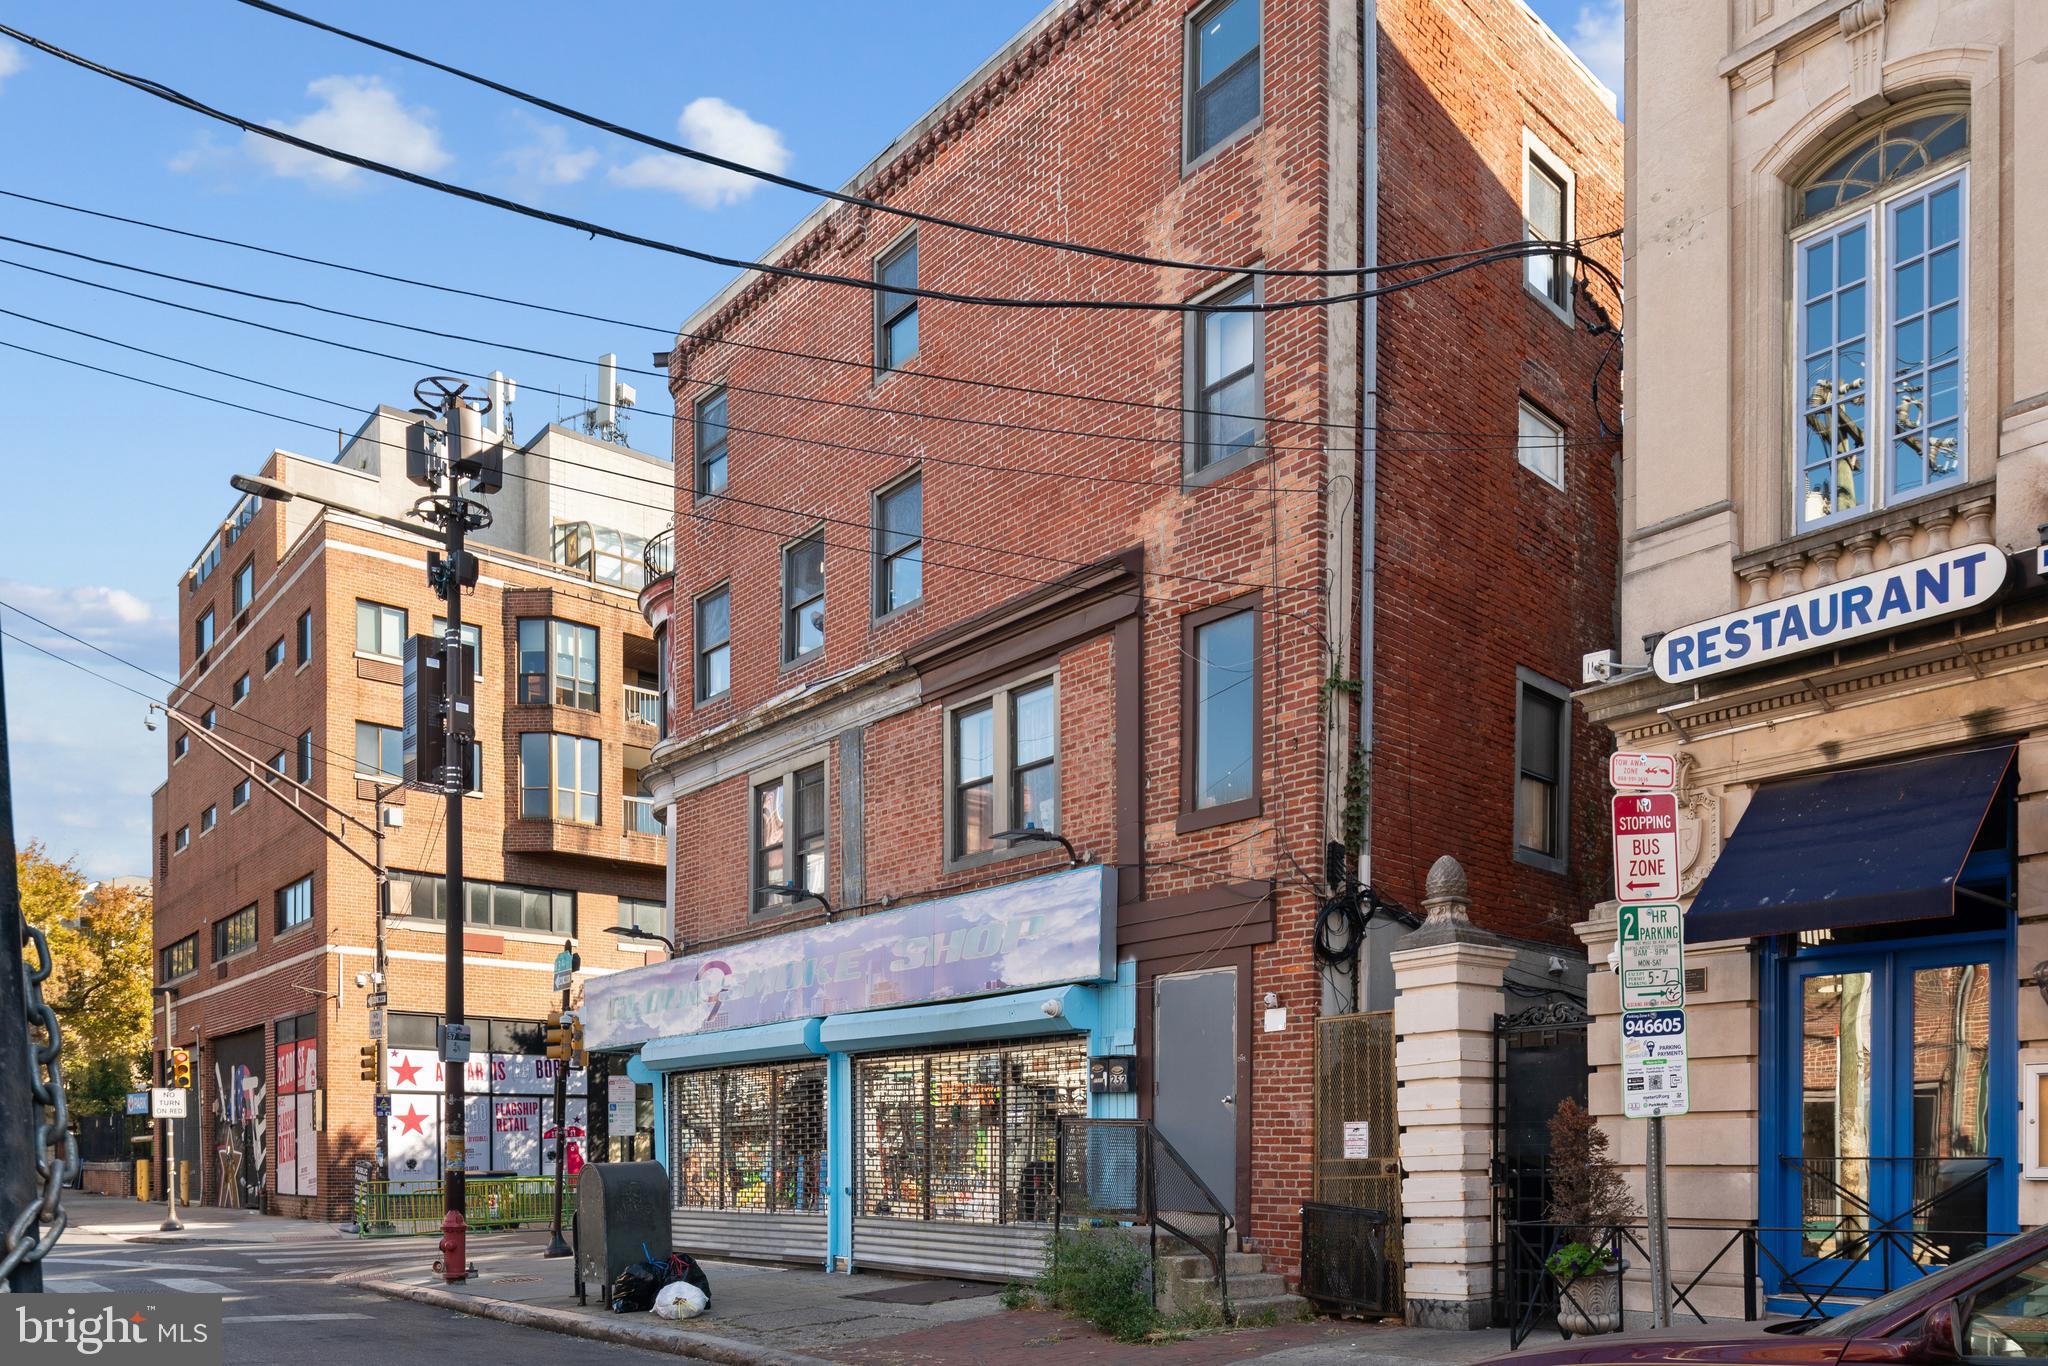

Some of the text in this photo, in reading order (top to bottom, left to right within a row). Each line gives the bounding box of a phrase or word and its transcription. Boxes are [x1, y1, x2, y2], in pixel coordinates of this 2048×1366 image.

[1668, 552, 1986, 676] RESTAURANT
[1637, 799, 1652, 813] NO
[1620, 815, 1671, 831] STOPPING
[1633, 839, 1660, 855] BUS
[1630, 859, 1665, 876] ZONE
[1652, 910, 1667, 923] HR
[1624, 913, 1634, 939] 2
[1640, 926, 1678, 940] PARKING
[889, 915, 1044, 973] SHOP
[1625, 1018, 1681, 1035] 946605
[436, 1062, 443, 1081] A
[492, 1061, 506, 1080] IS
[1109, 1074, 1127, 1085] 252
[496, 1102, 539, 1116] FLAGSHIP
[496, 1117, 529, 1132] RETAIL
